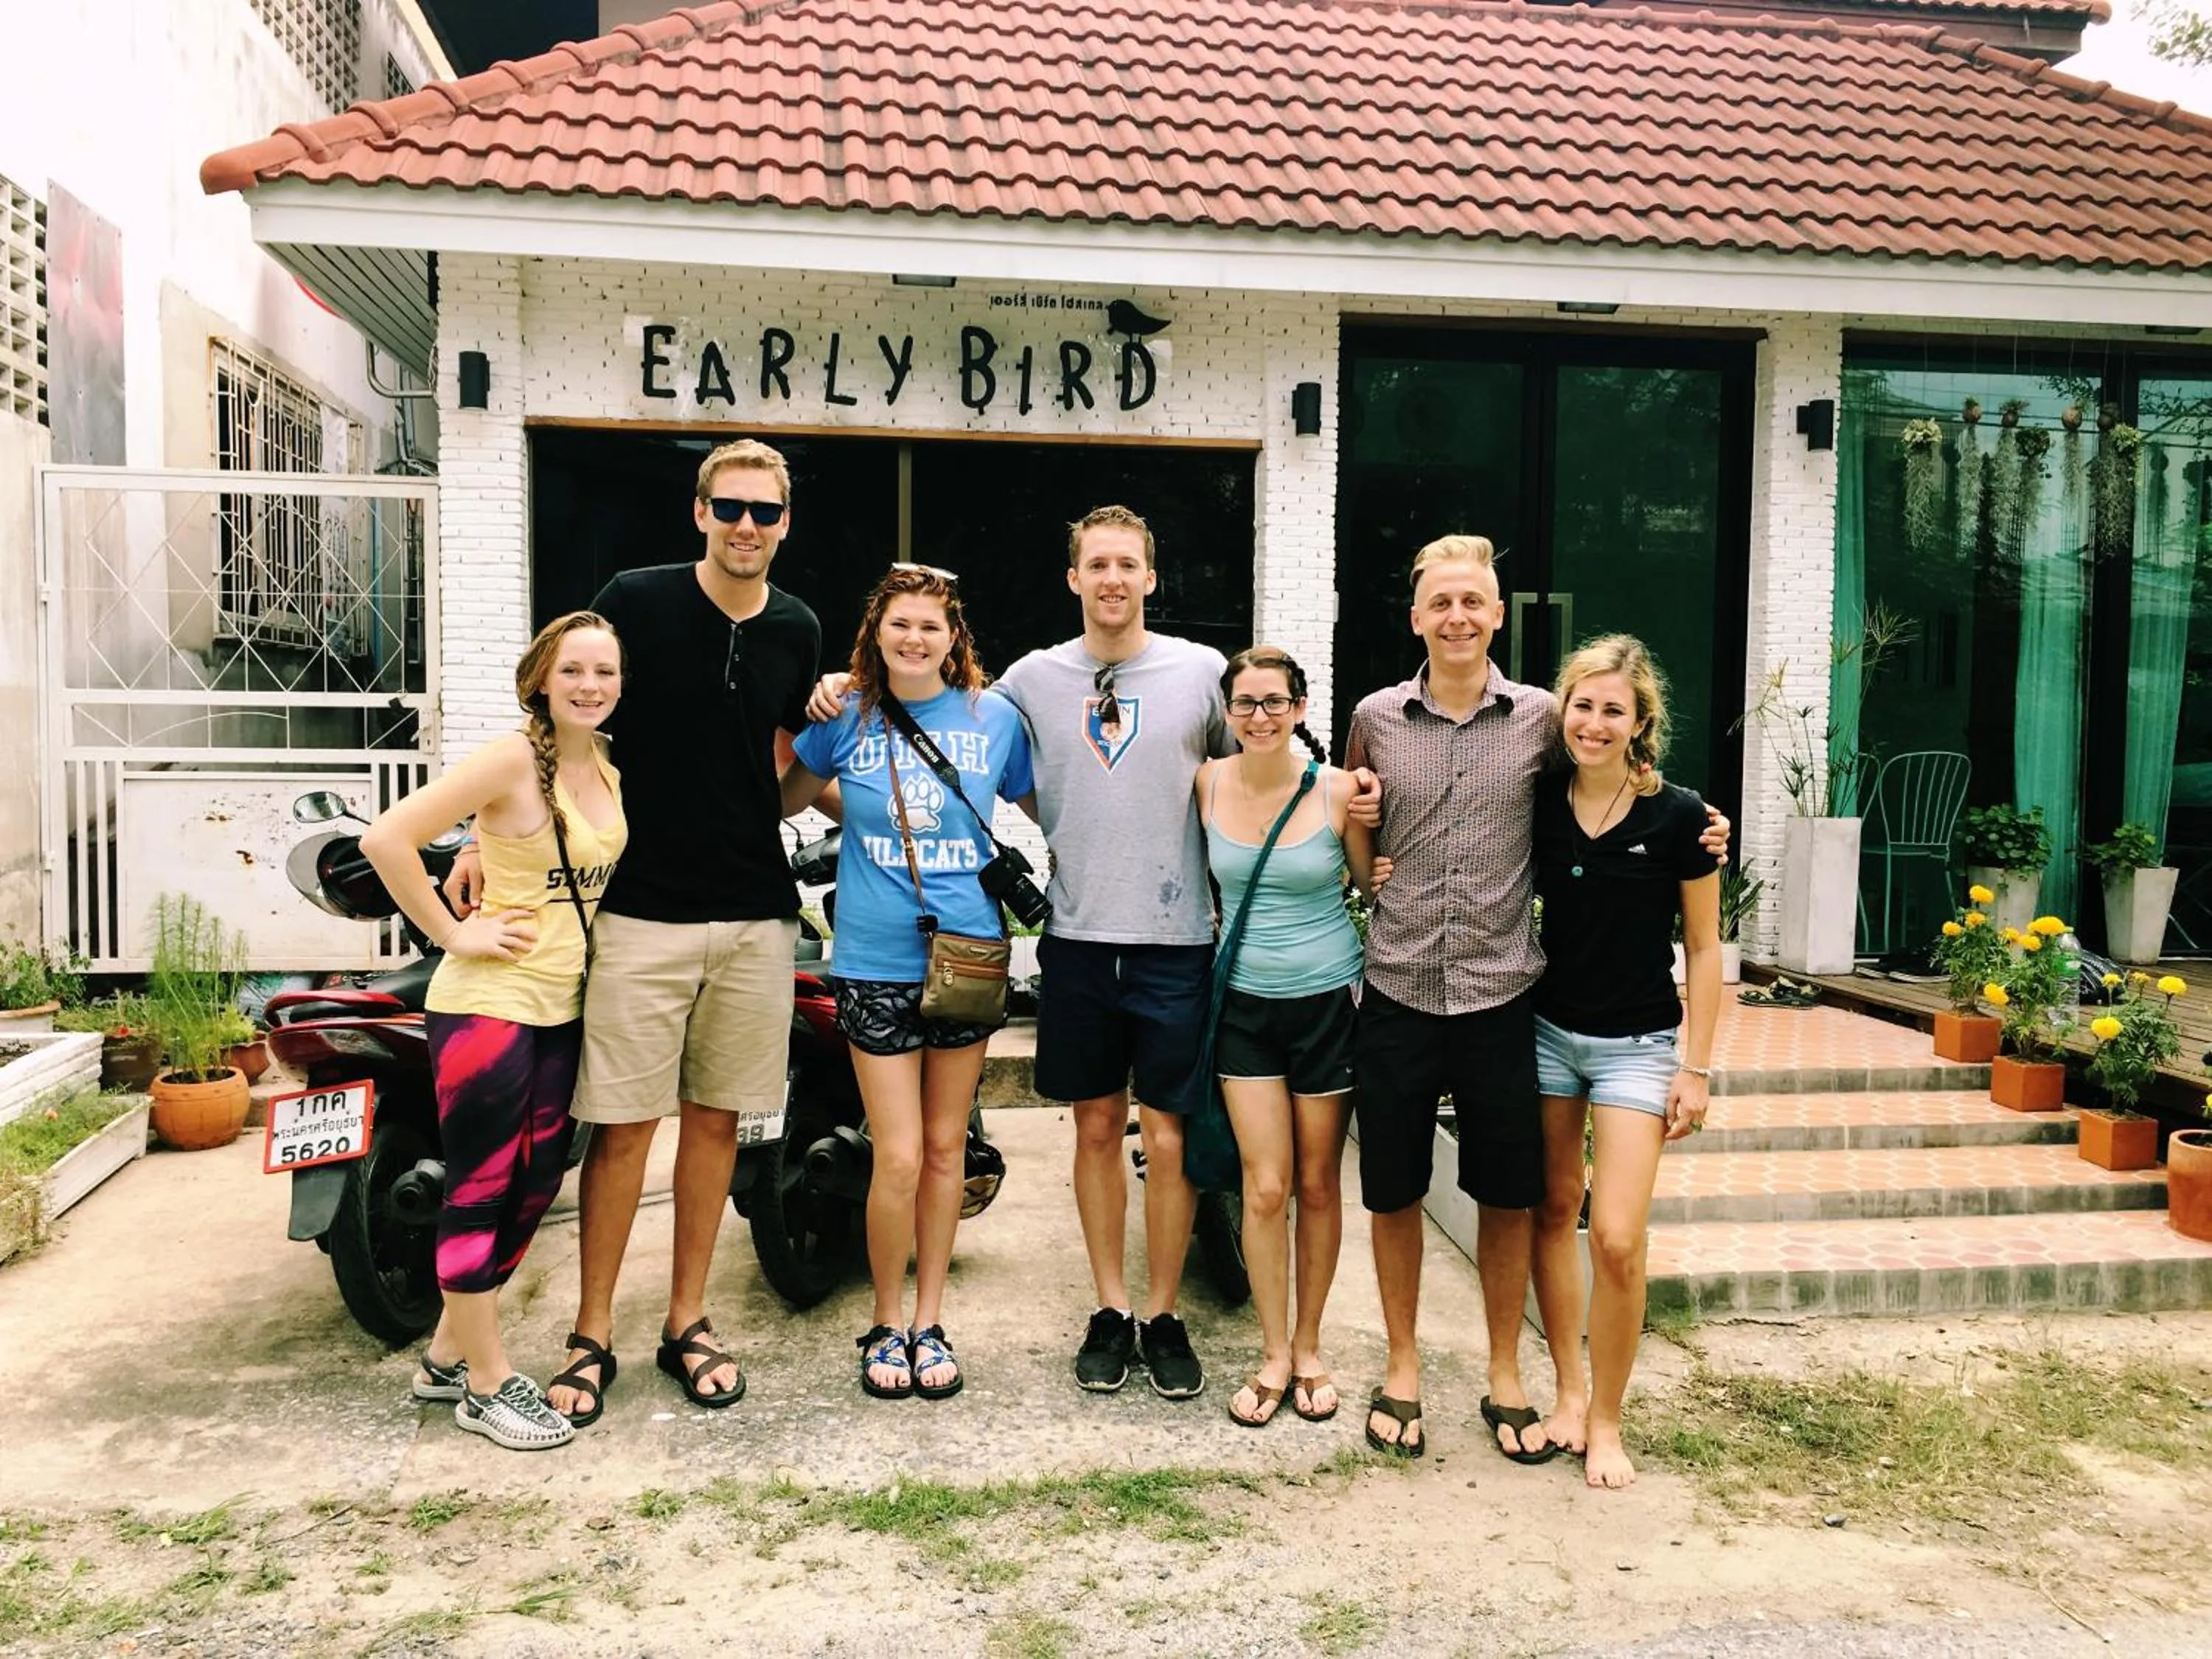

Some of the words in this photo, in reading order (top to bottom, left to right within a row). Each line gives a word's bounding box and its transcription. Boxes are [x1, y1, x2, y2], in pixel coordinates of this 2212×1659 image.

[641, 325, 914, 406] EARLY
[959, 325, 1157, 416] BIRD
[914, 734, 939, 763] Canon
[282, 1136, 350, 1164] 5620
